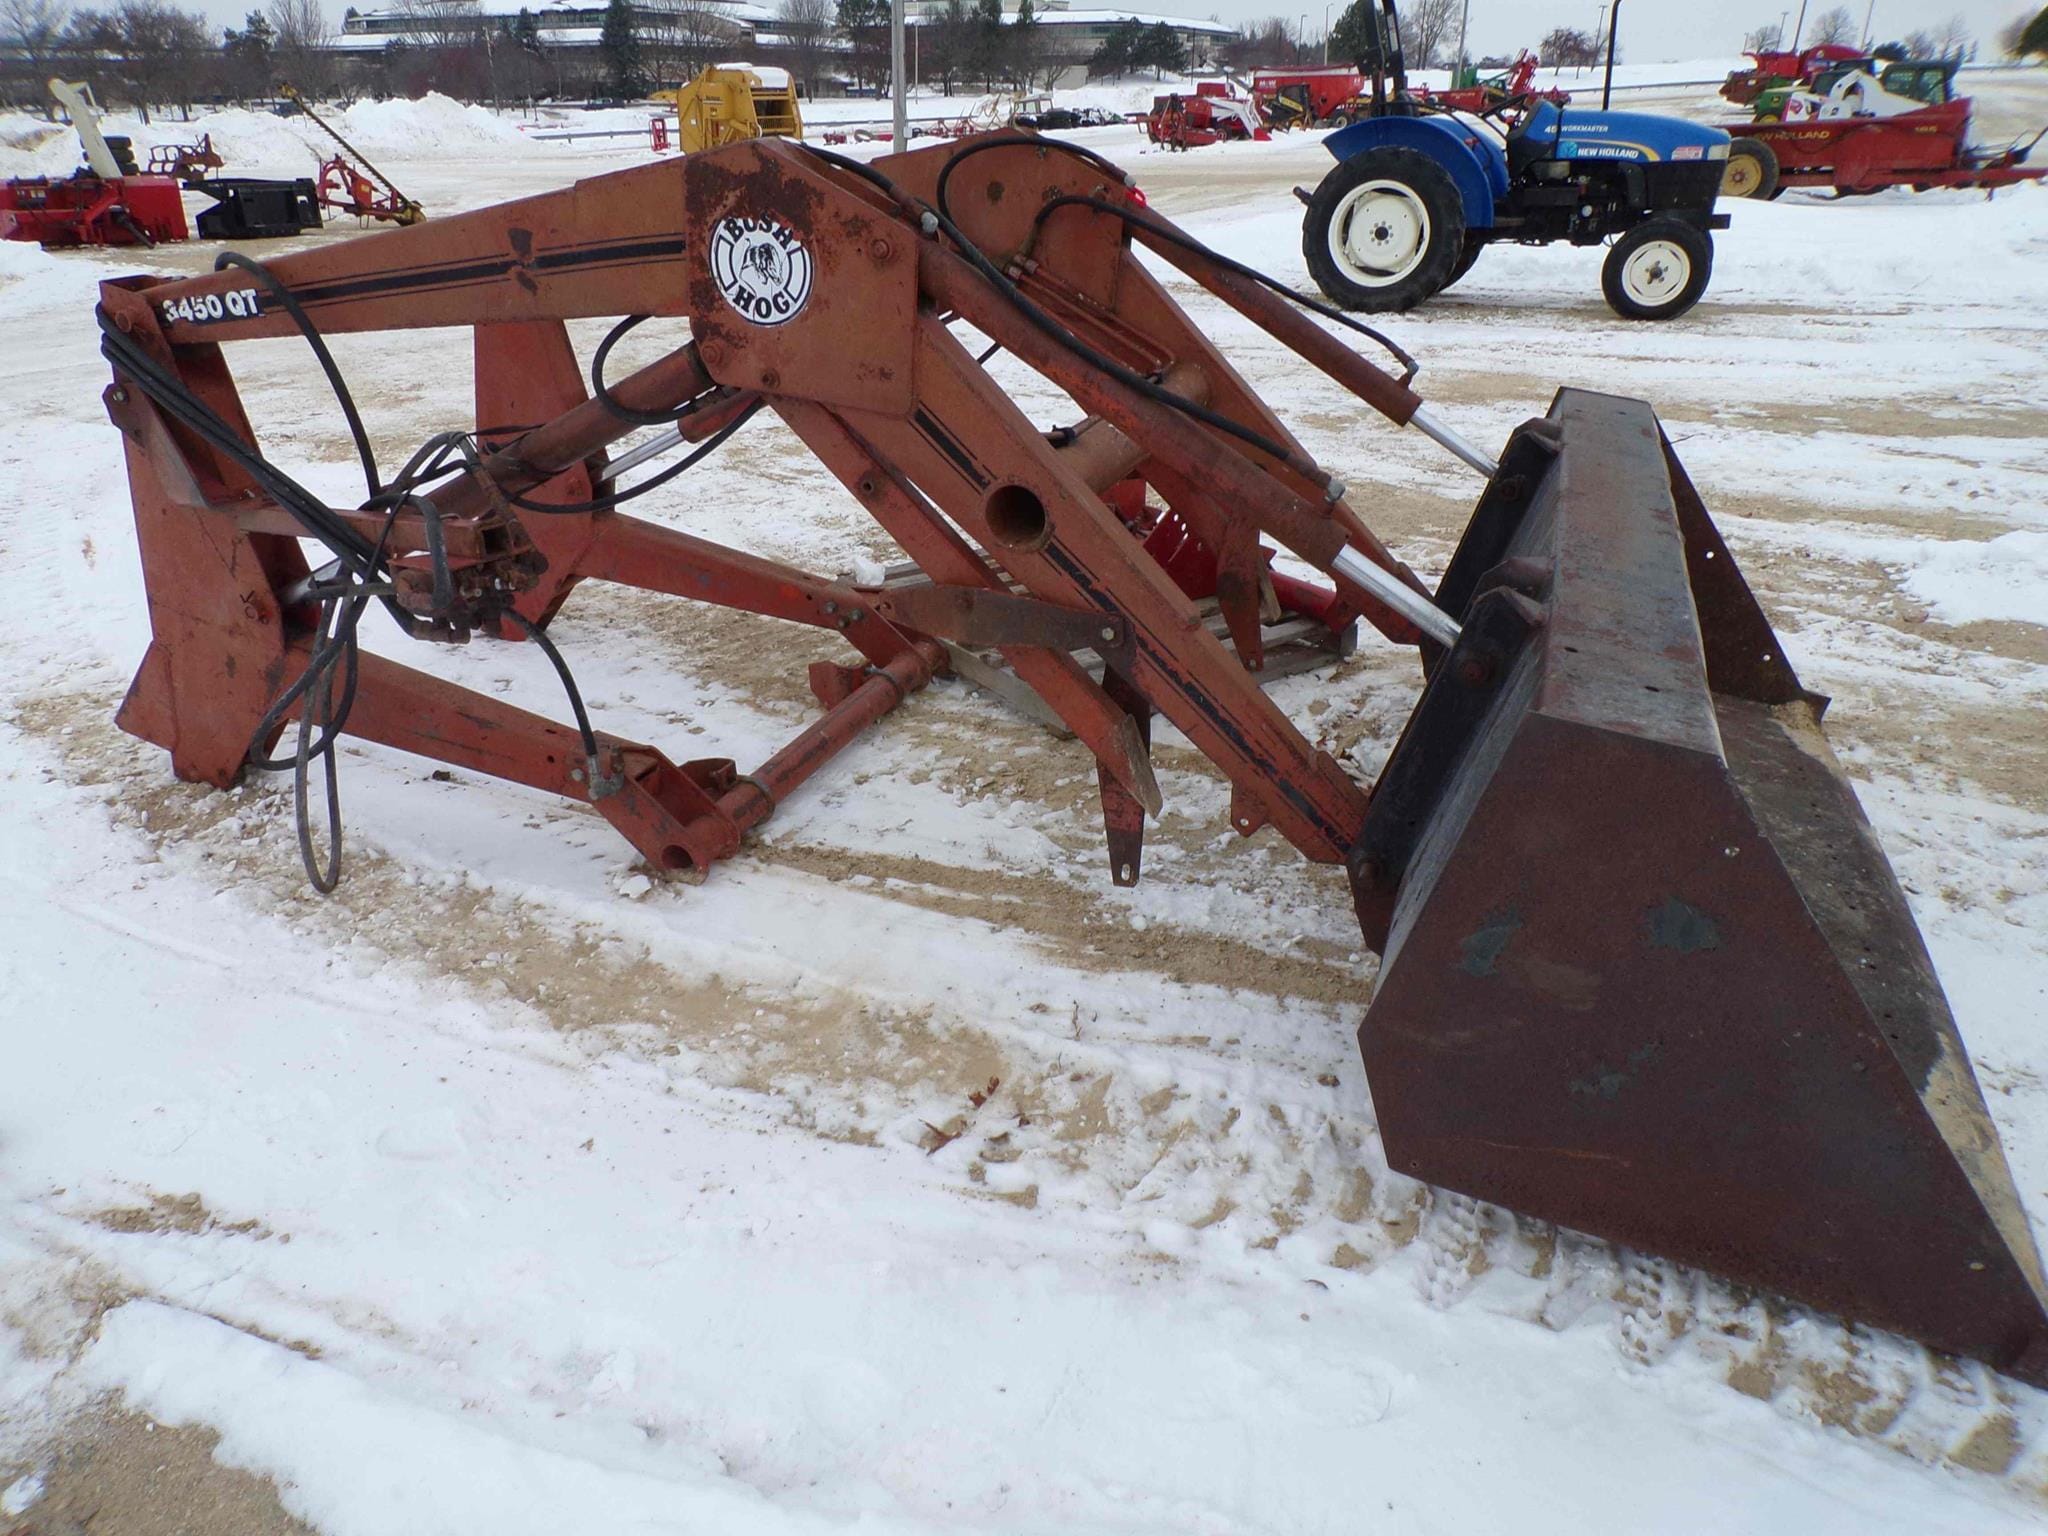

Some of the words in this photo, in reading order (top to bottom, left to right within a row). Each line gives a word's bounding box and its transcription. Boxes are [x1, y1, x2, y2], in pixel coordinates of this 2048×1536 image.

[1577, 147, 1597, 156] NEW
[1598, 148, 1639, 159] HOLLAND
[723, 212, 794, 250] BUSH
[162, 294, 224, 322] 3450
[225, 288, 259, 317] QT
[732, 284, 791, 319] HOG
